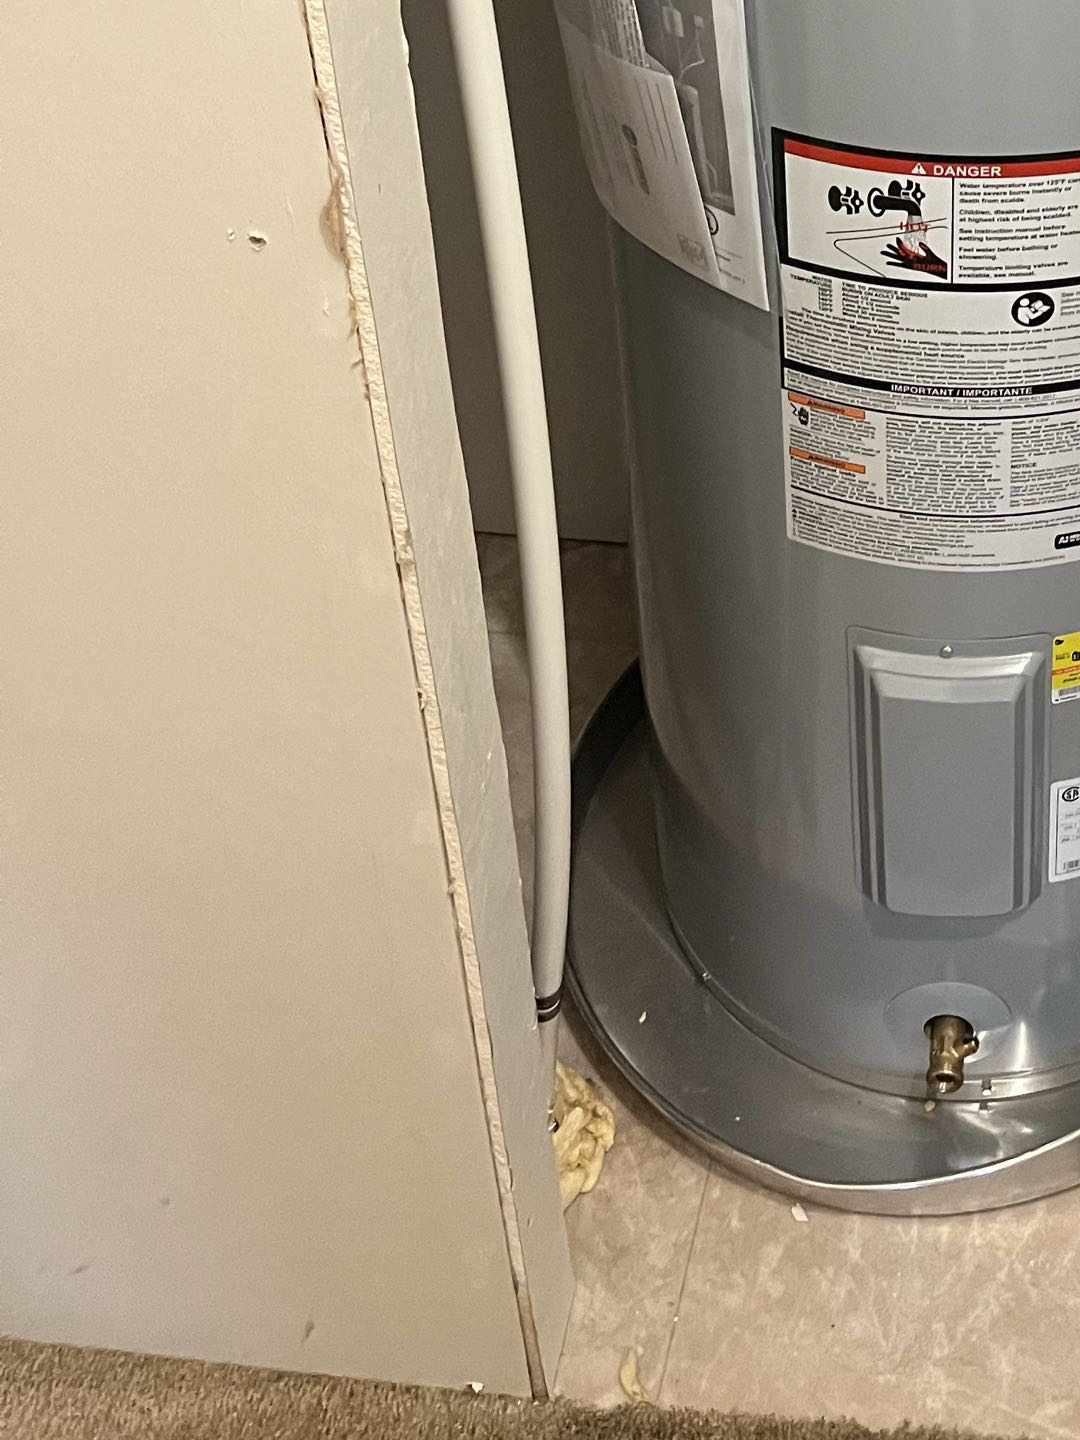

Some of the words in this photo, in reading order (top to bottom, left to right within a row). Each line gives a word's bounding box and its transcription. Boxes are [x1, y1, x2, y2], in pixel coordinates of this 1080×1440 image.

[933, 164, 1002, 177] DANGER
[890, 383, 954, 396] IMPORTANT
[962, 386, 1033, 397] IMPORTANTE
